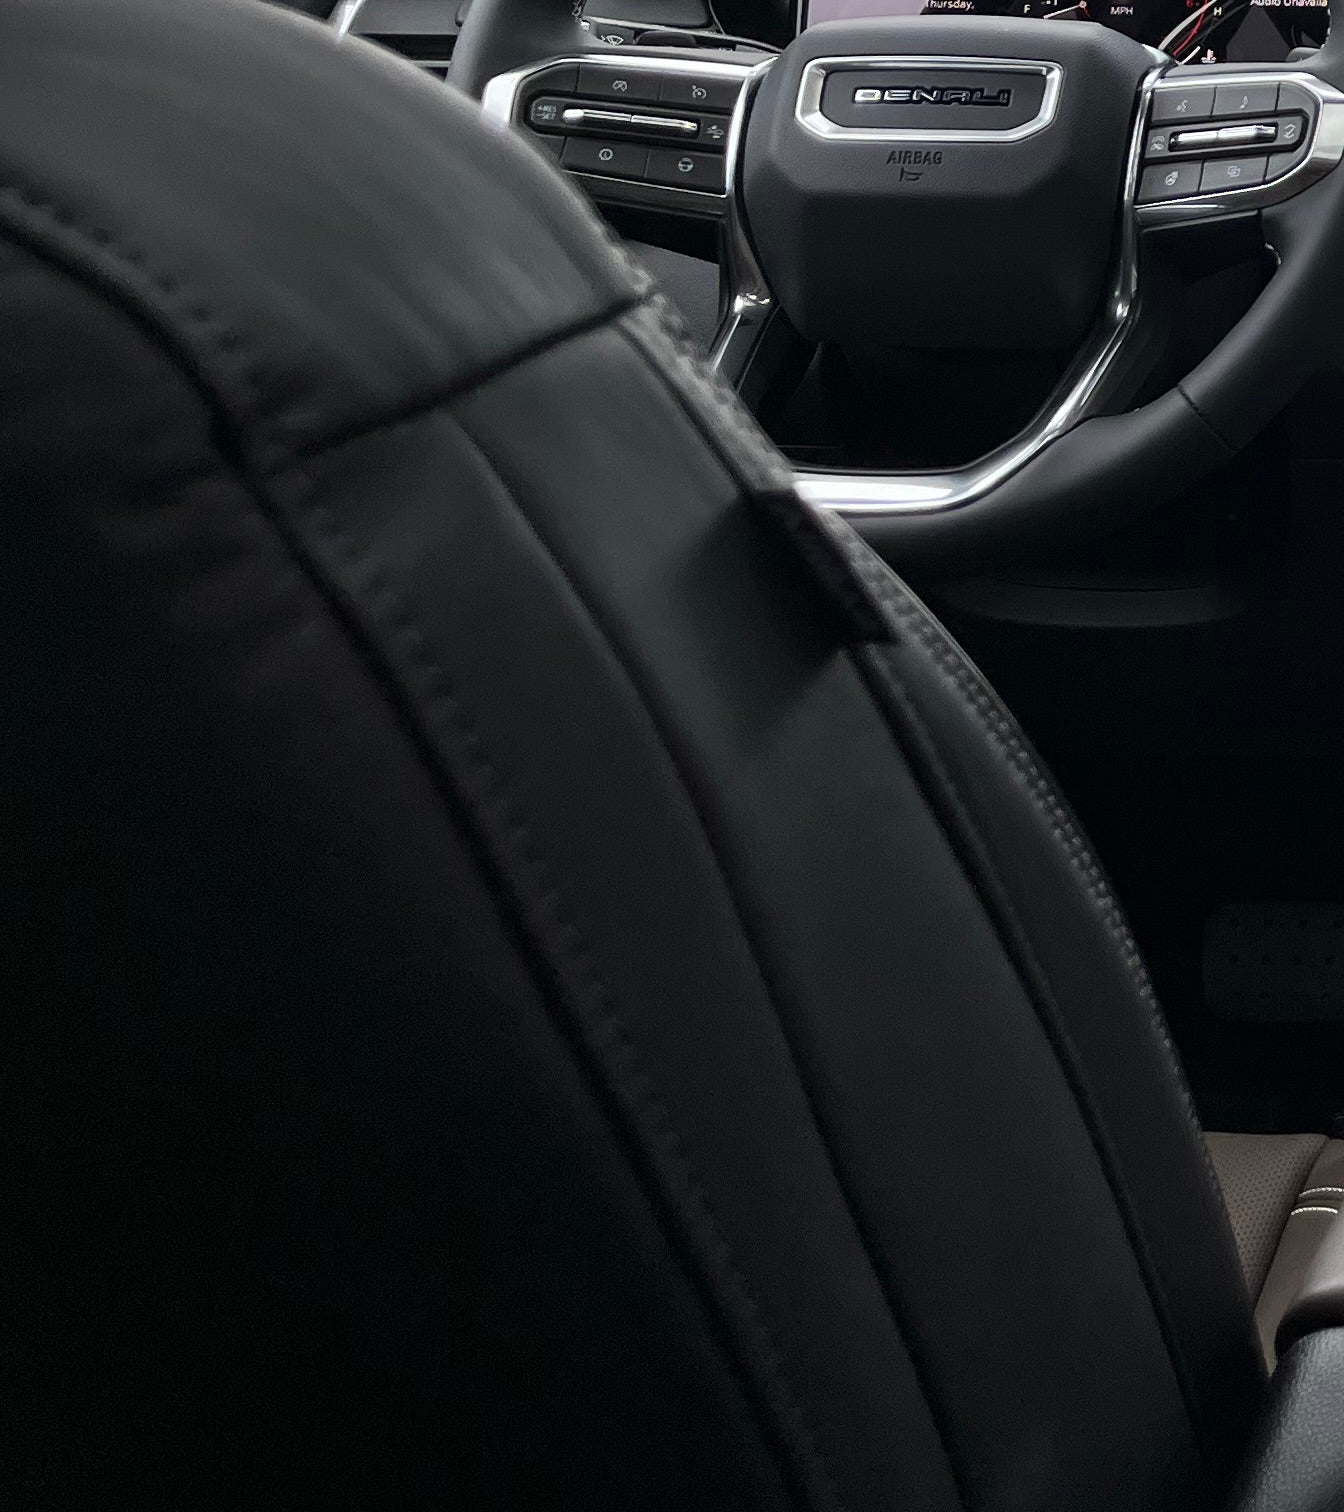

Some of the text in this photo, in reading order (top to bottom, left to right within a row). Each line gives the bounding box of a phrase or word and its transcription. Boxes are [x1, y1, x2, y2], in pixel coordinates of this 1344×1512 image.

[1110, 6, 1134, 16] MPH
[1213, 6, 1222, 16] H
[854, 87, 1012, 107] DENALI
[886, 150, 943, 165] AIRBAG
